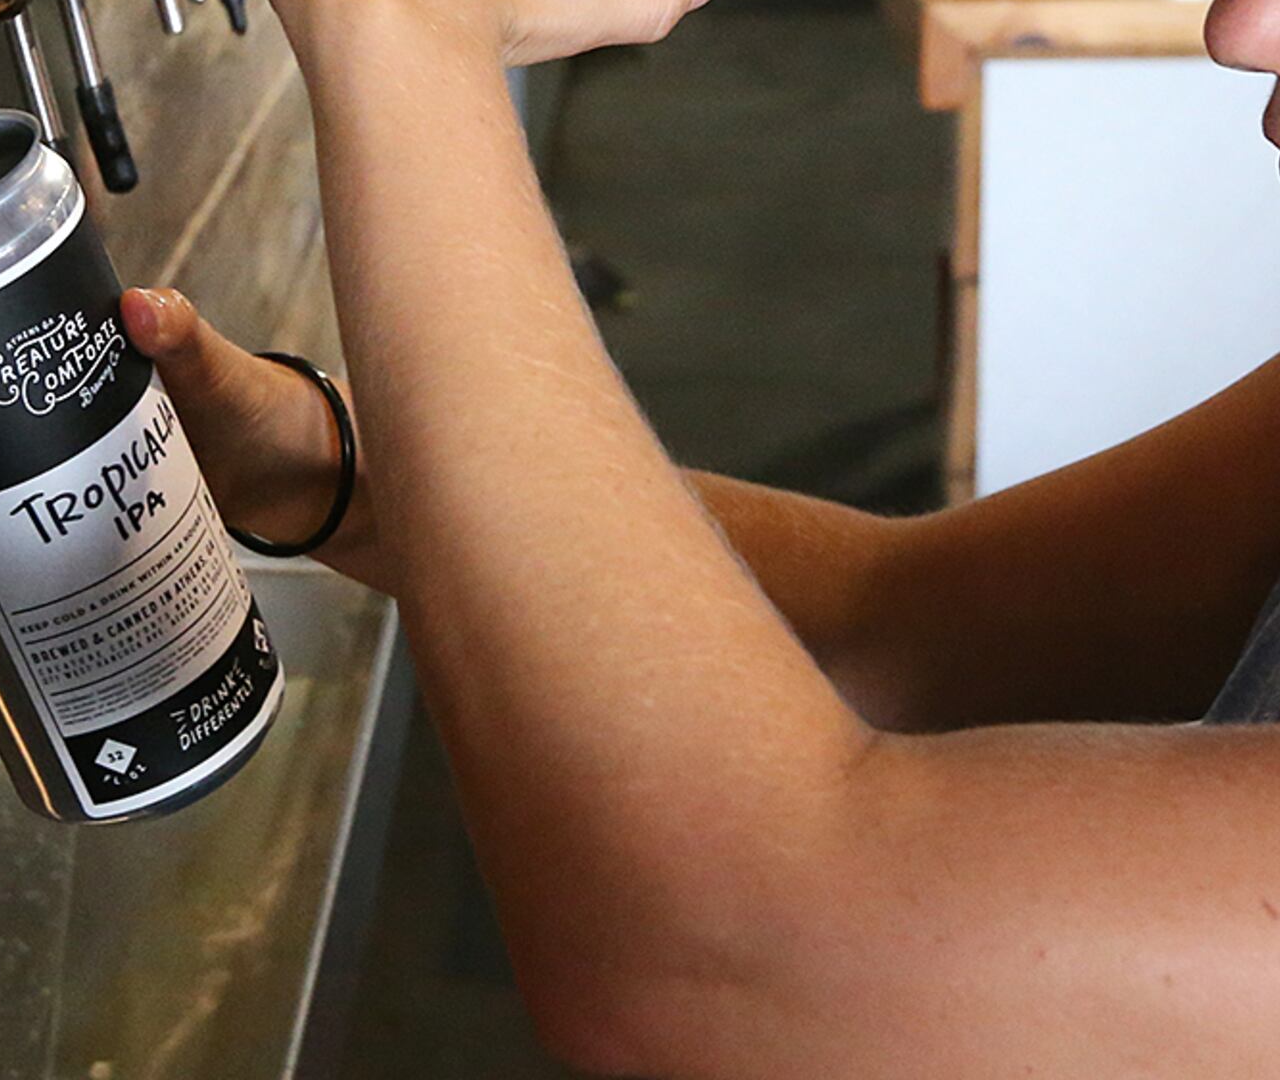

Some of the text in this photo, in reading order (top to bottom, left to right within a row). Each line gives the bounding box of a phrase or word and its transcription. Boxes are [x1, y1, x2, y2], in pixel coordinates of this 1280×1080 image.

[22, 317, 126, 415] COMFORTS
[113, 490, 166, 541] IPA
[19, 621, 49, 634] KEEP
[52, 607, 86, 625] COLD
[100, 581, 136, 606] DRINK
[137, 552, 172, 583] WITHIN
[30, 638, 88, 664] BREWED
[93, 632, 104, 645] &
[106, 601, 158, 637] CANNED
[159, 590, 173, 606] IN
[179, 675, 255, 751] DIFFERENTLY
[190, 671, 238, 722] DRINK
